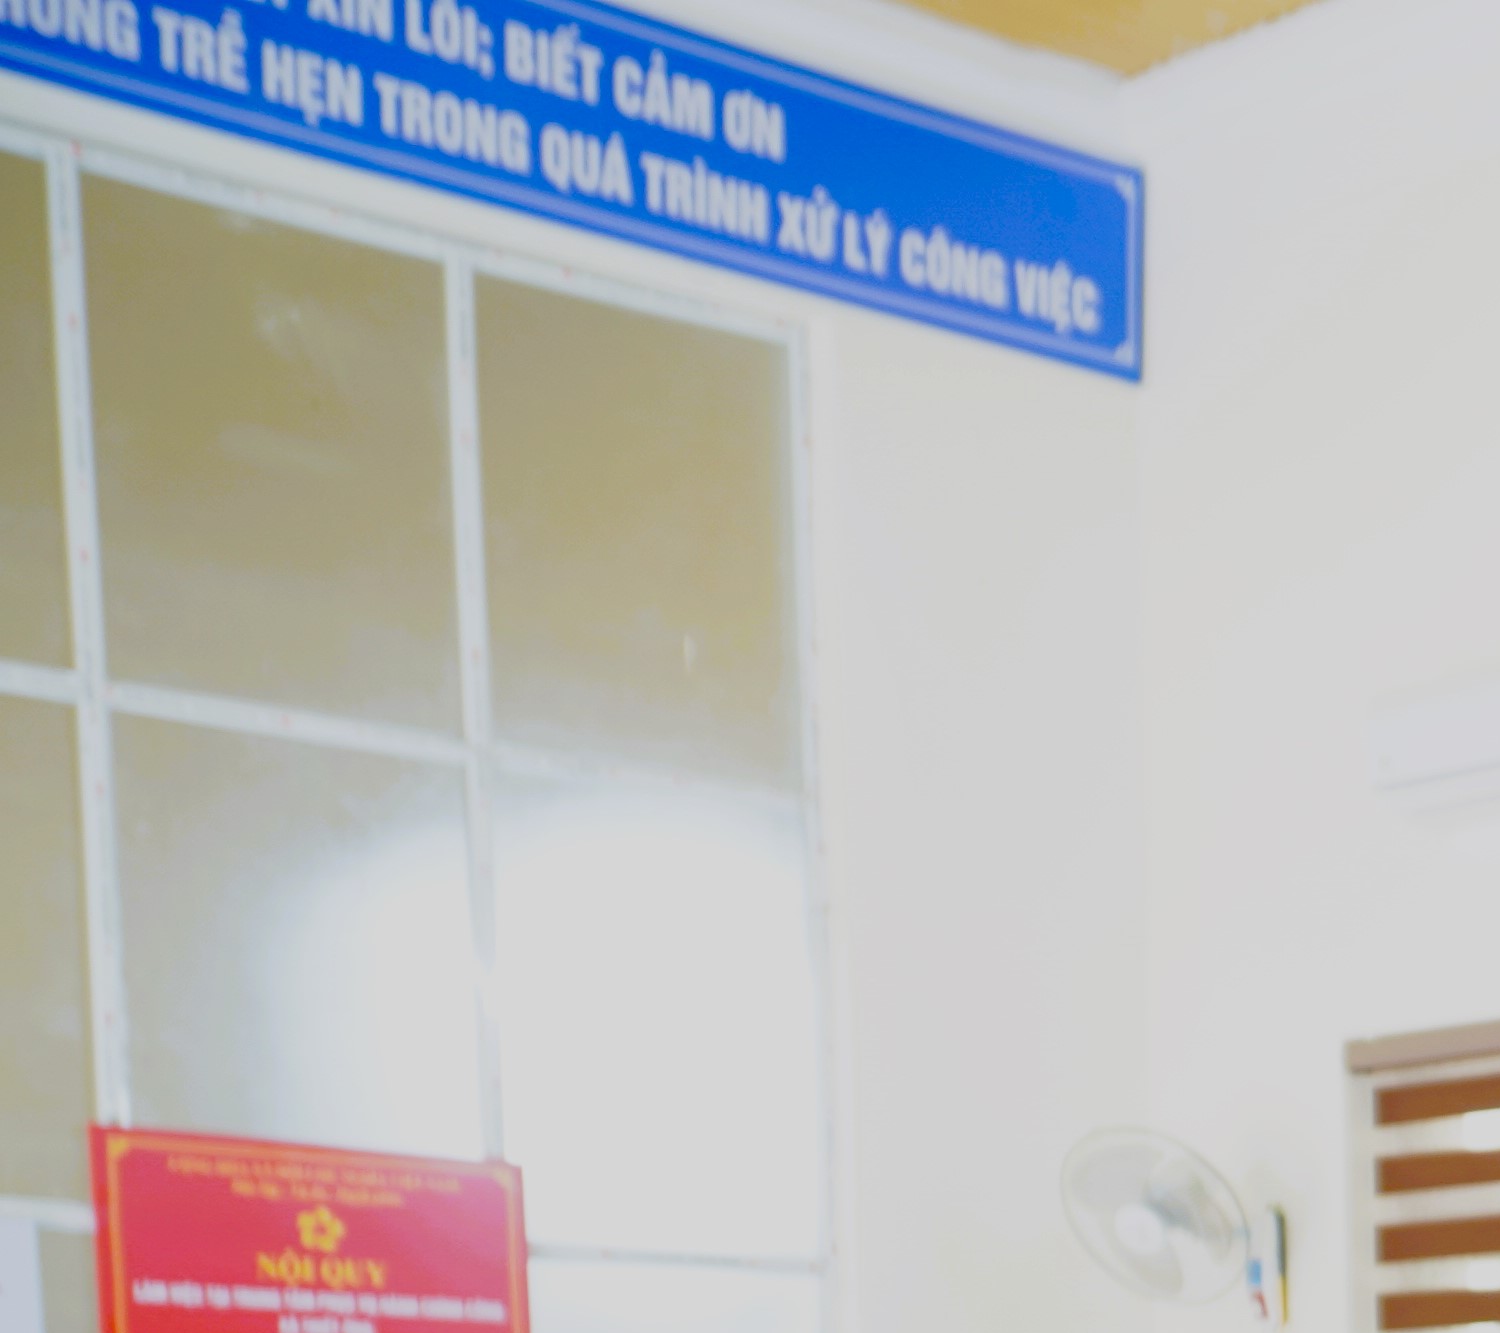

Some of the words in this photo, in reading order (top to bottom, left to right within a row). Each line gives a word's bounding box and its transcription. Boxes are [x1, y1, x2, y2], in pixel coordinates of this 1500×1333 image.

[261, 38, 364, 128] HẸN
[374, 71, 531, 176] TRONG
[899, 224, 1012, 311] CÔNG
